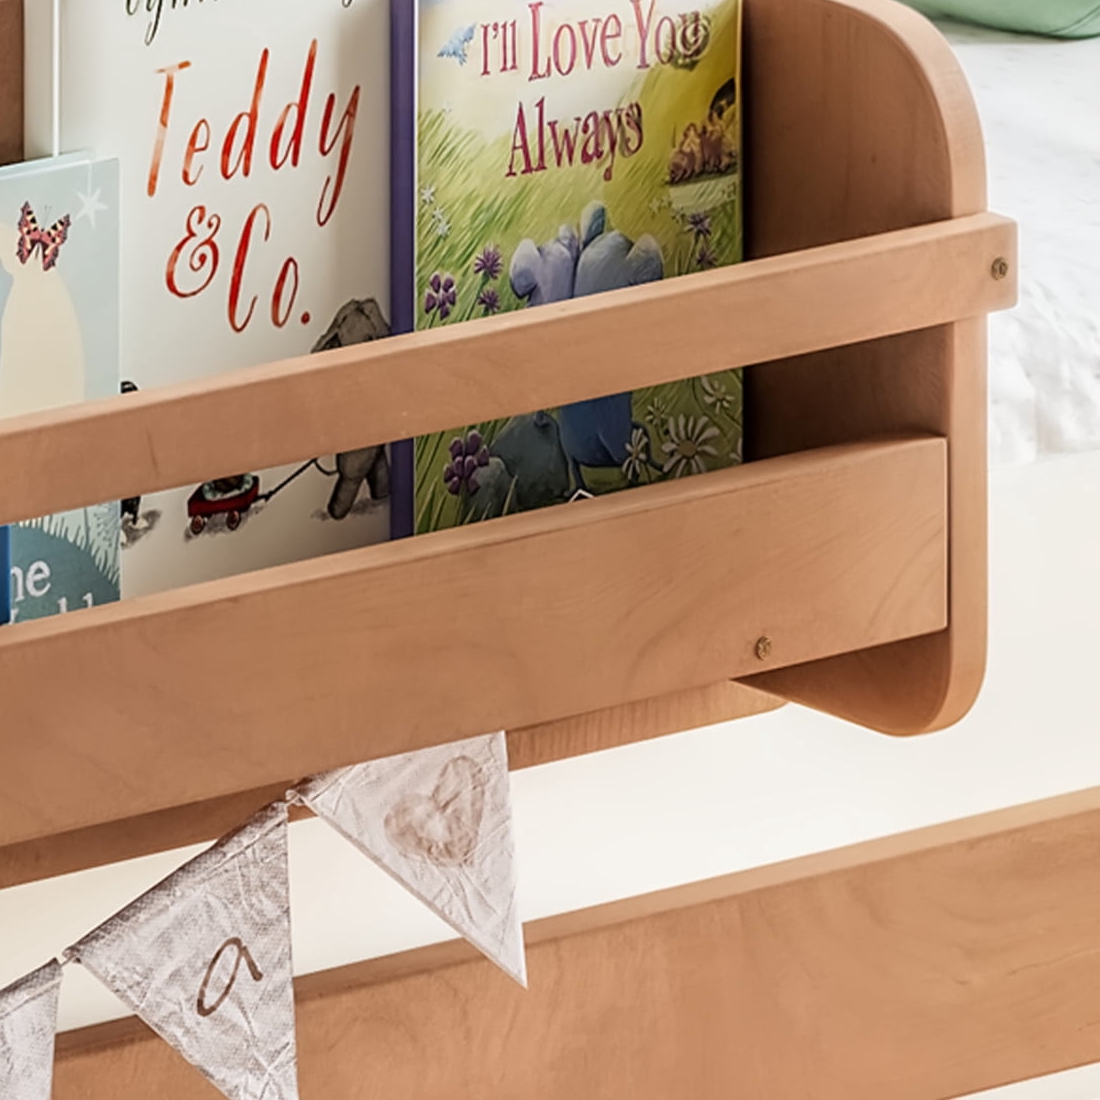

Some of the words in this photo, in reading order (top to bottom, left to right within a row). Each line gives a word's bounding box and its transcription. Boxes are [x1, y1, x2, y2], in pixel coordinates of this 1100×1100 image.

[528, 1, 622, 82] Love
[146, 38, 361, 227] Teddy
[504, 96, 644, 181] Always
[227, 202, 312, 333] Co.
